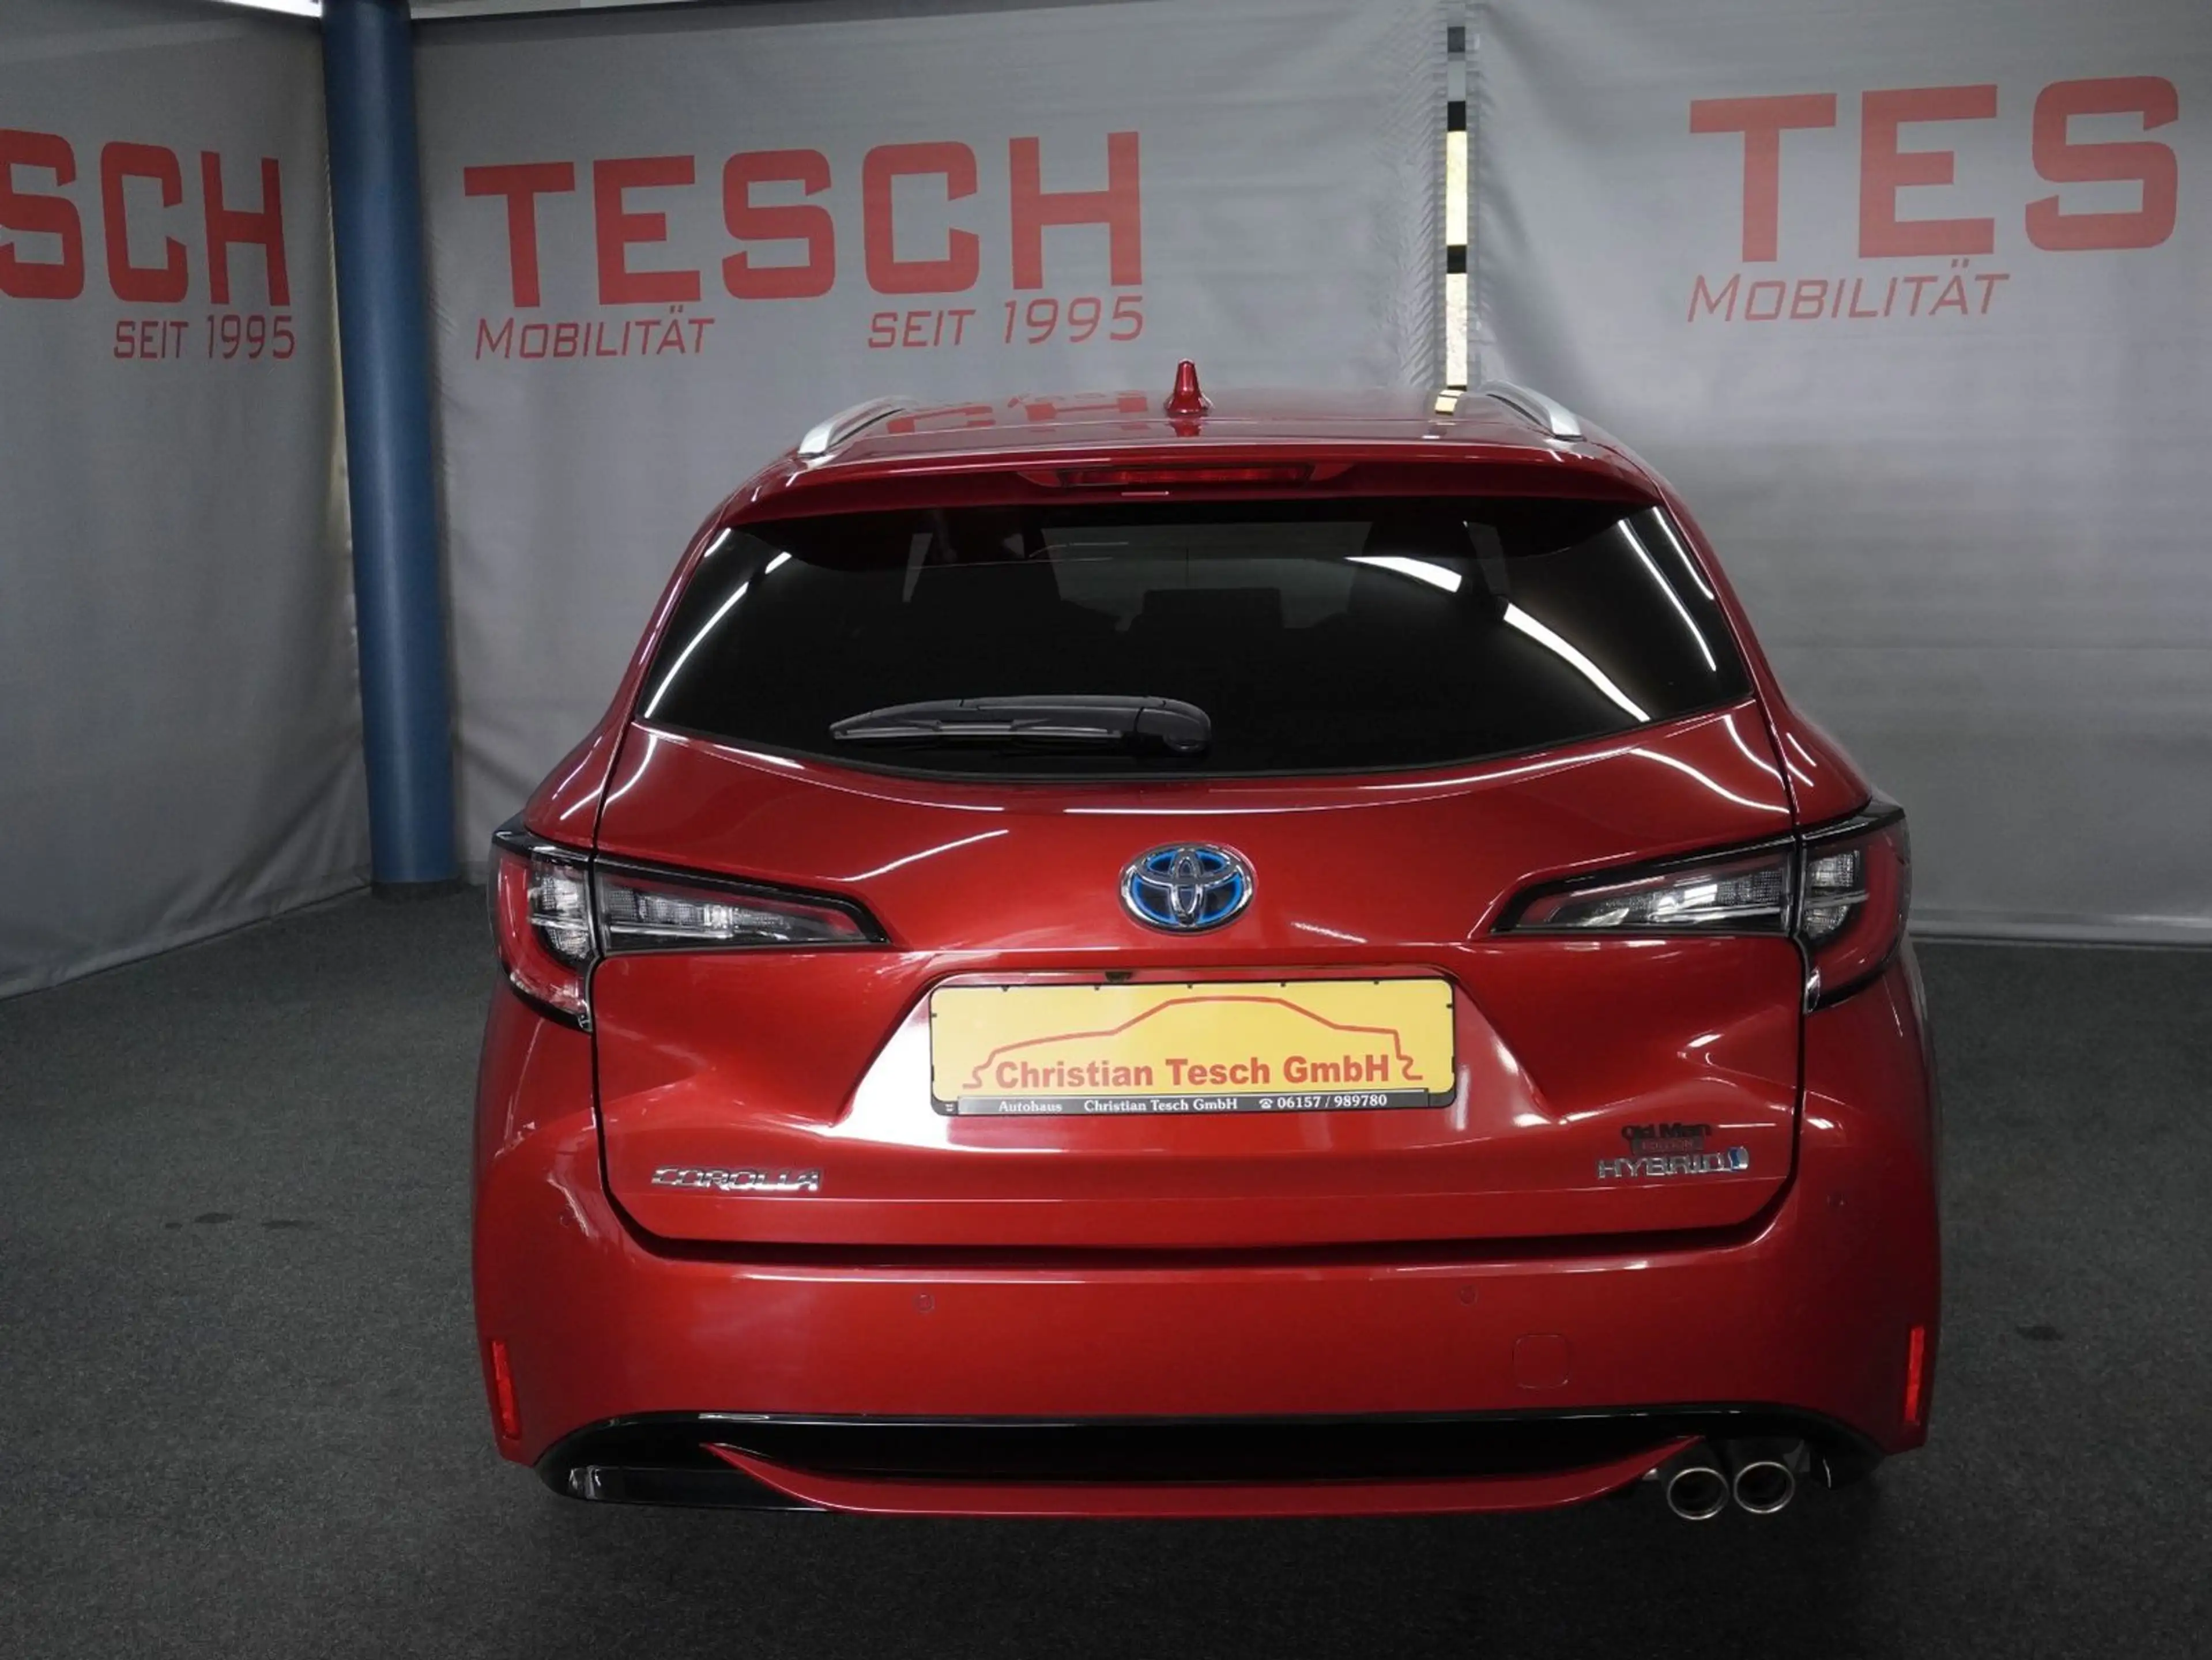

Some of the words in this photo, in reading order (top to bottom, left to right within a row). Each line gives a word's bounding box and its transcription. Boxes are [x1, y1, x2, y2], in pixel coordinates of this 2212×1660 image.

[1689, 76, 2179, 262] TES
[0, 129, 290, 306] SCH
[463, 131, 1142, 307] TESCH
[114, 320, 189, 359] SEIT
[207, 315, 295, 359] 1995
[868, 309, 975, 349] SEIT
[1004, 295, 1143, 344] 1995
[996, 1061, 1153, 1089] Christian
[1166, 1057, 1271, 1086] Tesch
[1283, 1054, 1389, 1084] GmbH
[998, 1100, 1063, 1112] Autohaus
[1084, 1099, 1146, 1112] Christian
[1151, 1097, 1189, 1111] Tesch
[1193, 1096, 1238, 1110] GmbH
[1277, 1095, 1320, 1108] 06157
[1335, 1093, 1387, 1107] 989780
[651, 1165, 820, 1191] COROLLA
[1599, 1153, 1725, 1178] HYBRID
